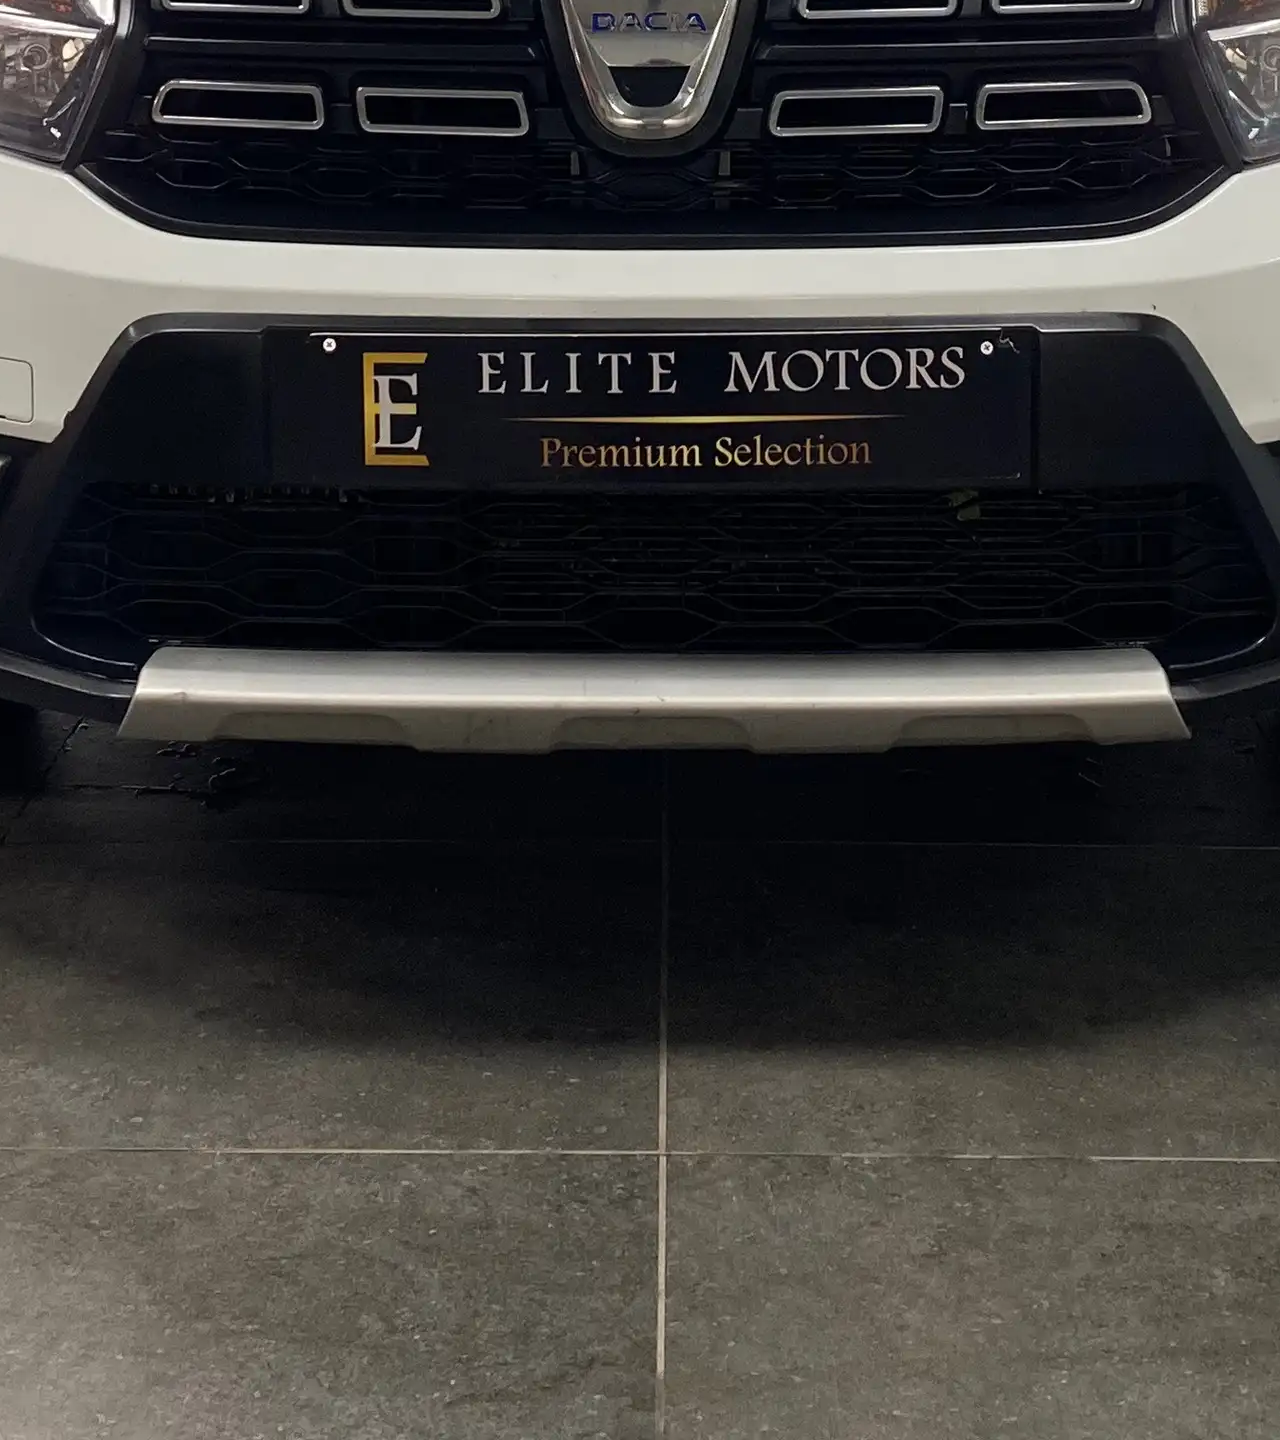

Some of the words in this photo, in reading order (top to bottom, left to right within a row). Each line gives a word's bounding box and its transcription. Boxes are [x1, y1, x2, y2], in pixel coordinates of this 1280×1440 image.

[591, 12, 708, 32] DACIA
[477, 351, 677, 395] ELITE
[723, 346, 966, 393] MOTORS
[540, 436, 702, 468] Premium
[715, 434, 872, 467] Selection
